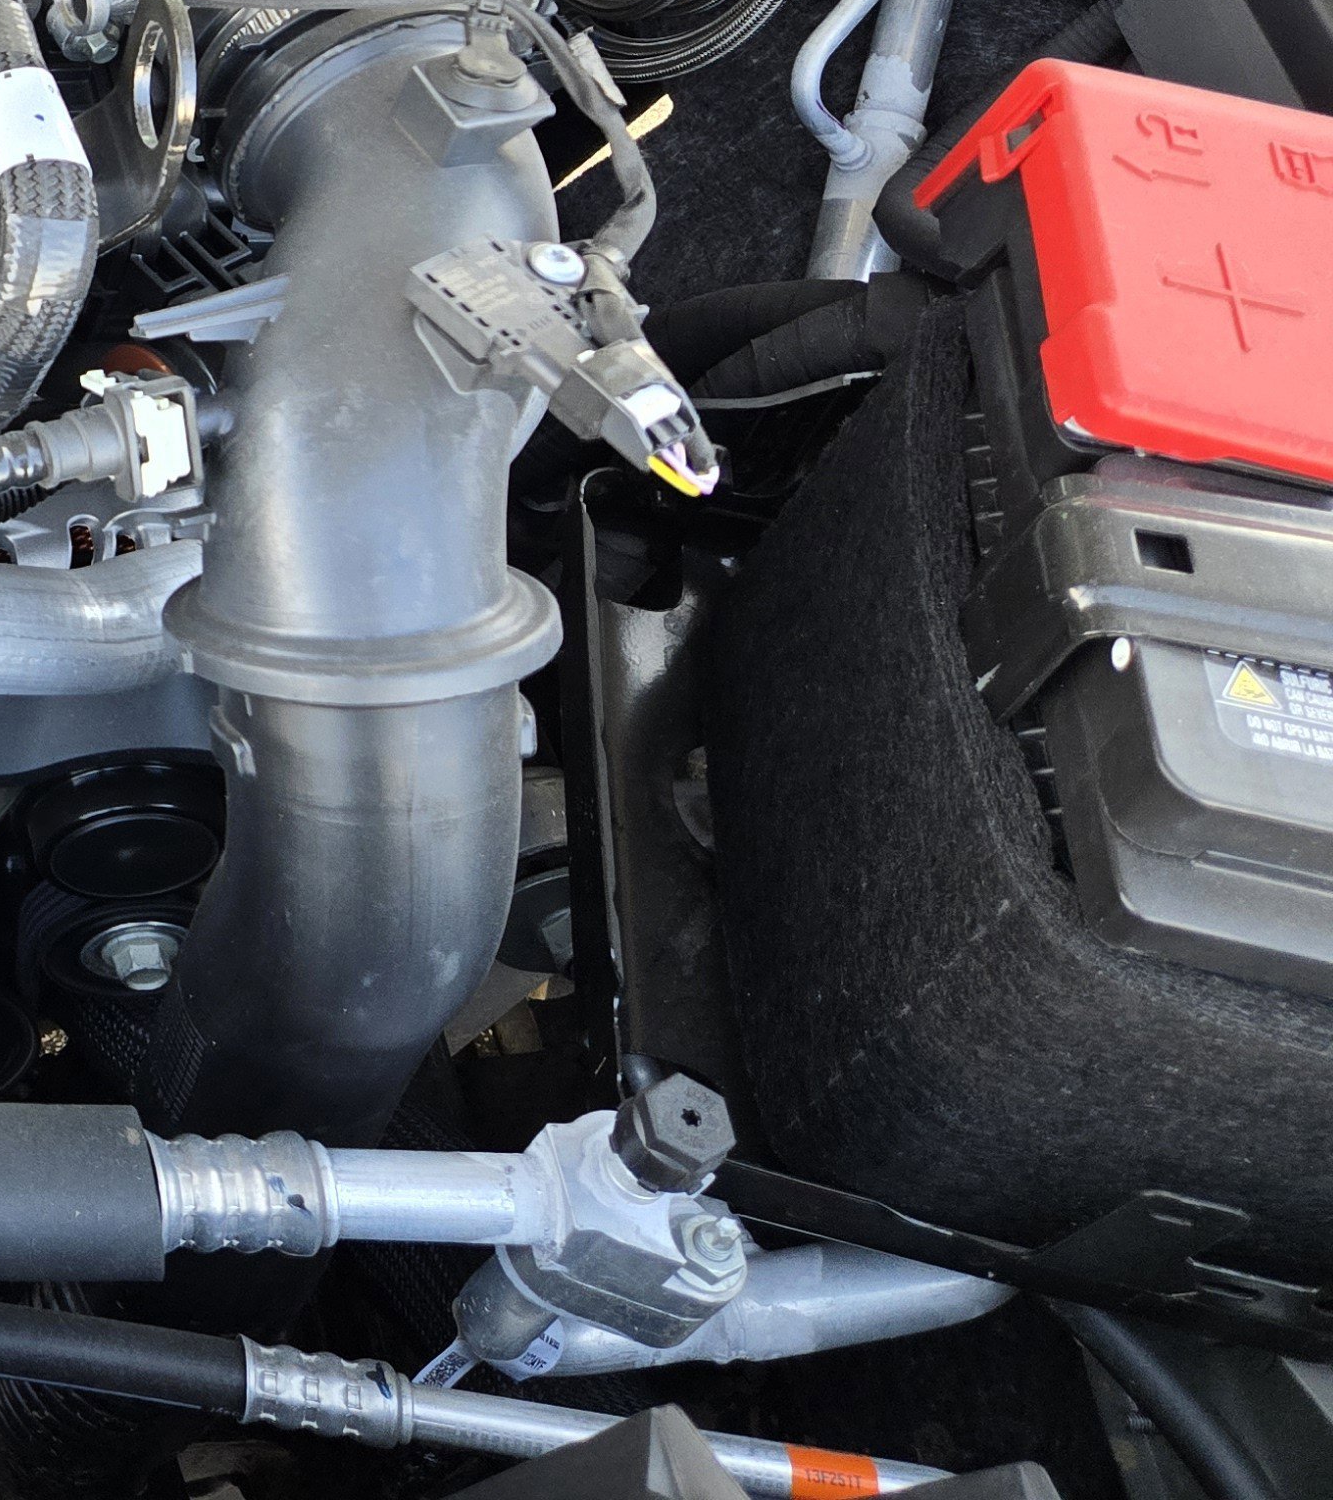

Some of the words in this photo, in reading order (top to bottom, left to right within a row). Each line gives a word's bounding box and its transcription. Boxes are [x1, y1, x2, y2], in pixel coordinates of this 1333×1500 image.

[1246, 713, 1262, 729] DO
[1262, 718, 1282, 733] NOT
[1283, 722, 1311, 739] OPEN
